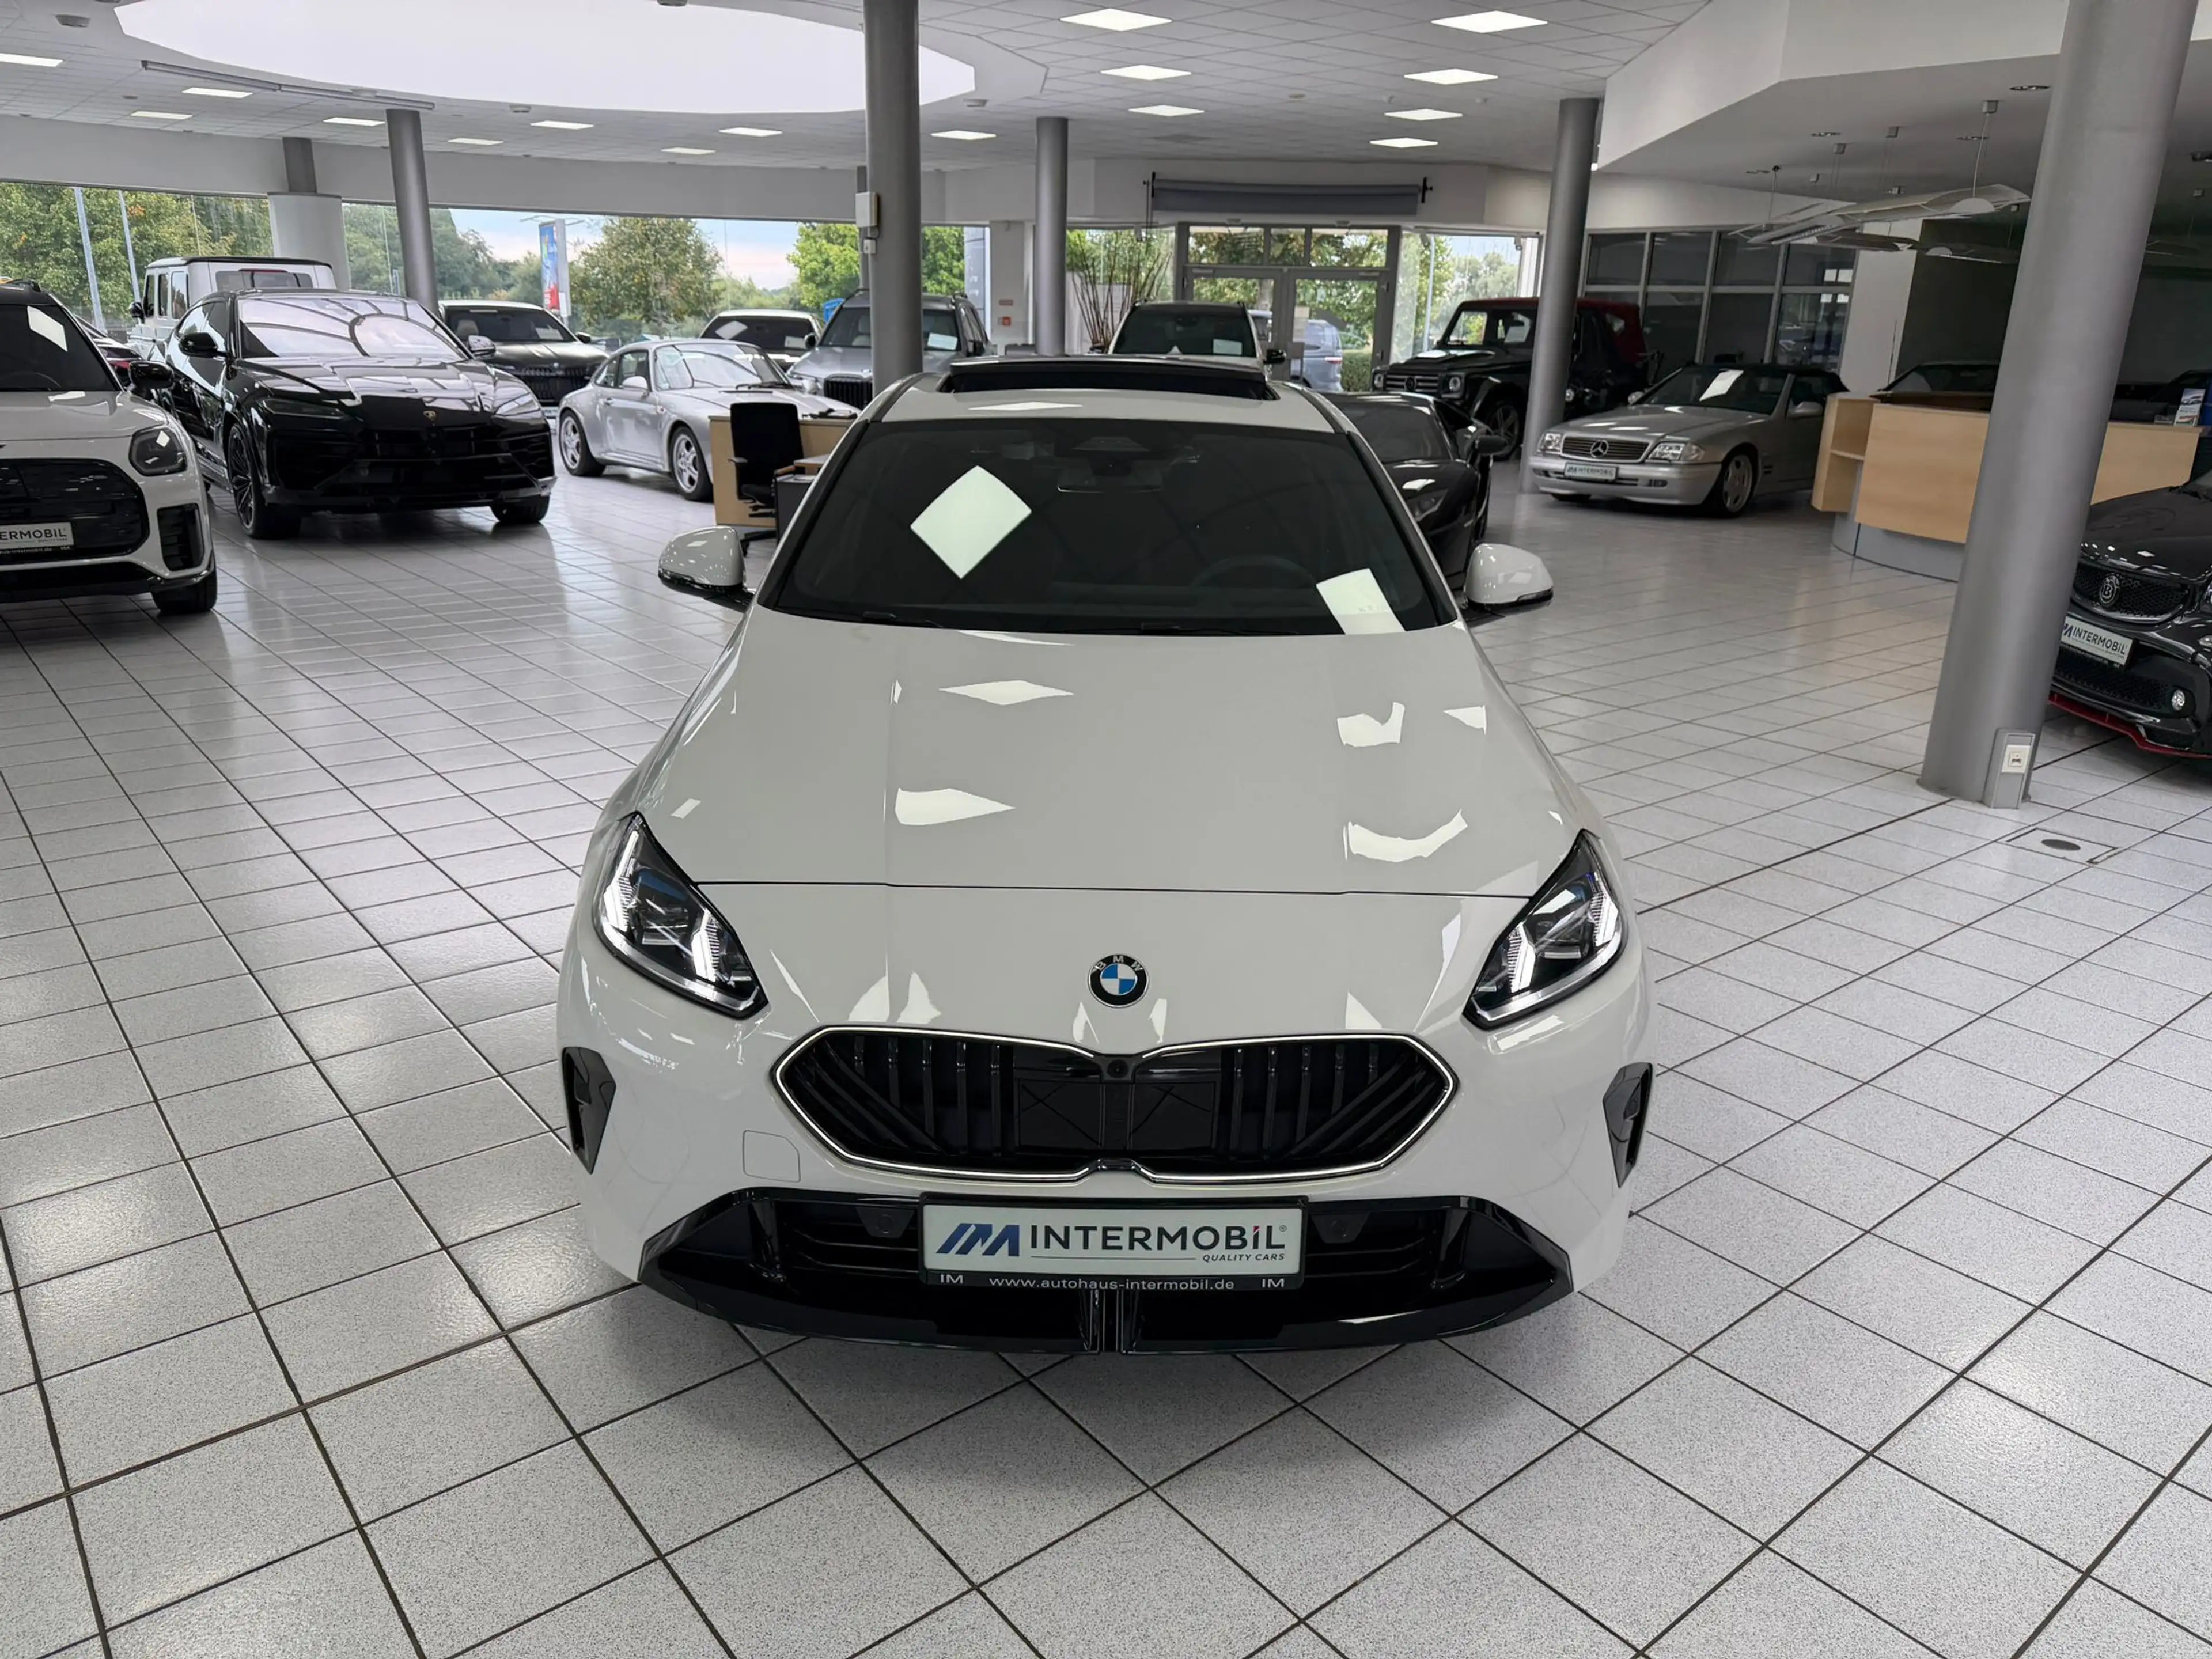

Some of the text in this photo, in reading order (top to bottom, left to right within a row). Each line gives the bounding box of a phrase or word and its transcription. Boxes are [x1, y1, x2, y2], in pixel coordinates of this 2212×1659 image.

[2073, 626, 2127, 655] INTERMOBIL
[1093, 956, 1143, 972] BMW
[1203, 1254, 1251, 1263] QUALITY
[940, 1274, 1285, 1290] IM www.autohaus-intermobil.de IM
